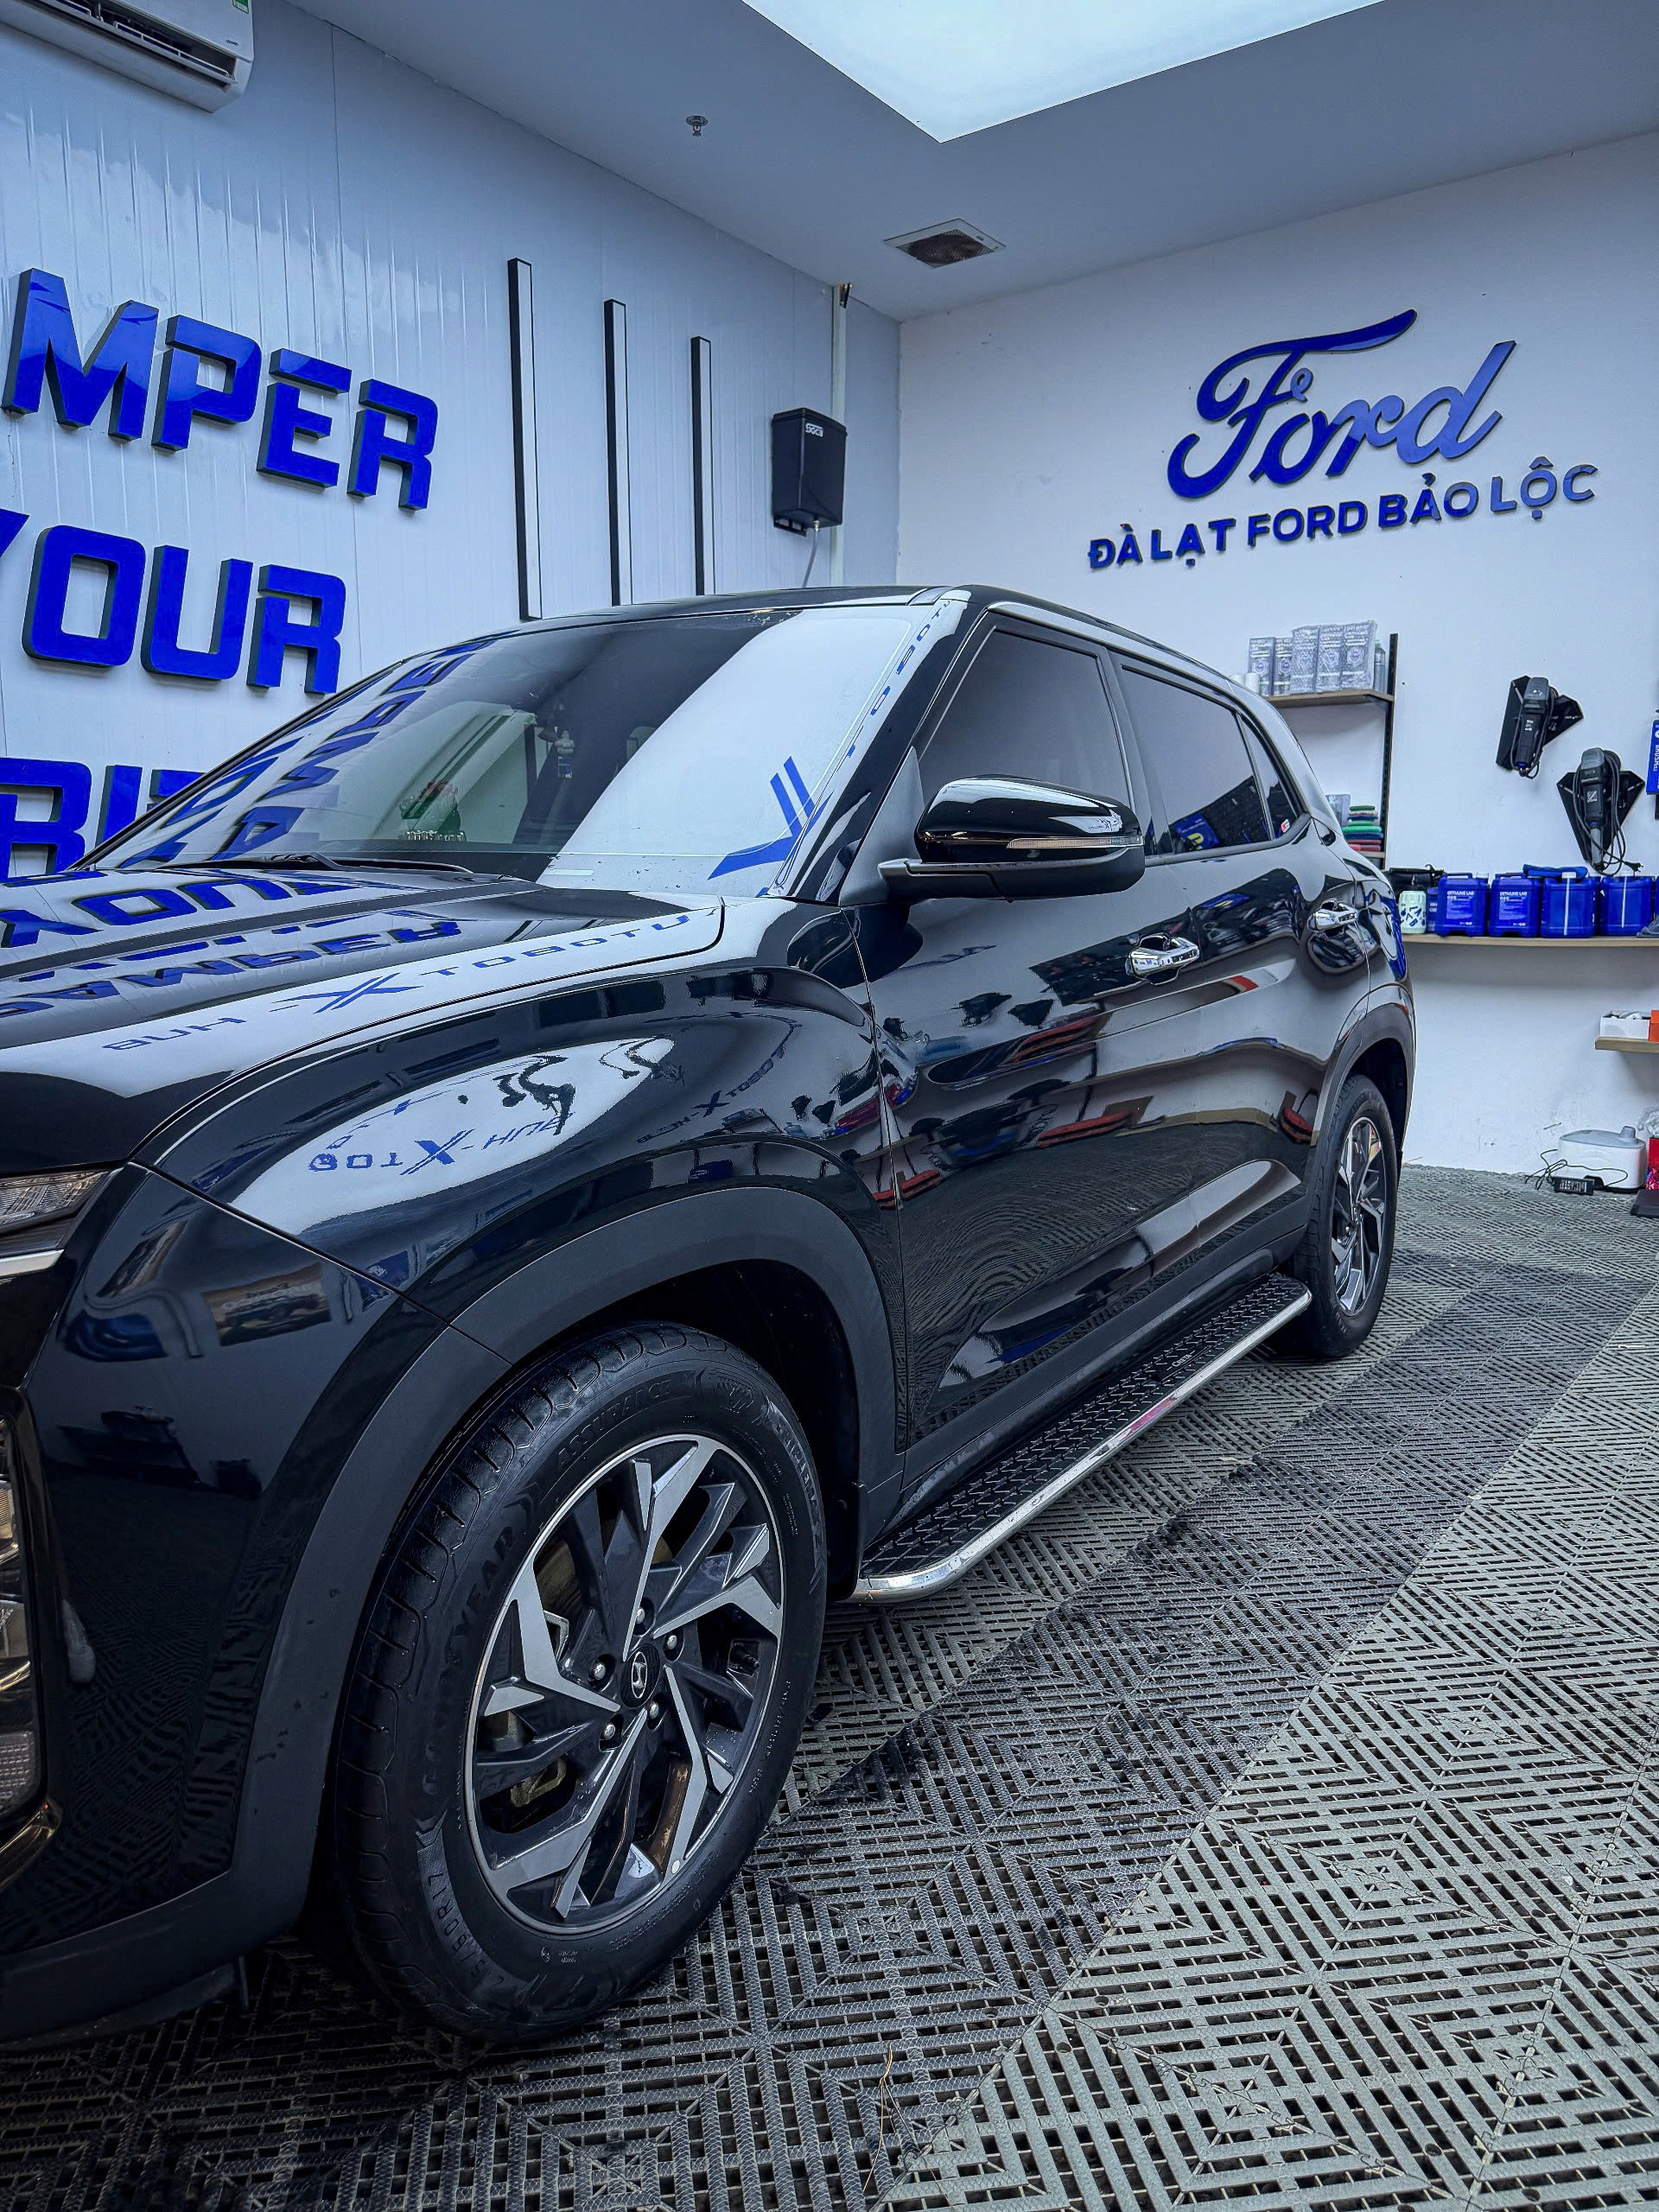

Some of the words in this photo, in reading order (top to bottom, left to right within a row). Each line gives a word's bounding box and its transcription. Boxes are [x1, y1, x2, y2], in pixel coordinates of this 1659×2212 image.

[1167, 308, 1516, 499] Ford
[0, 509, 346, 694] OUR
[1089, 522, 1142, 569] ĐÀ
[1150, 518, 1237, 568] LẠT
[1247, 500, 1369, 548] FORD
[1378, 473, 1479, 528] BẢO
[1491, 456, 1599, 520] LỘC
